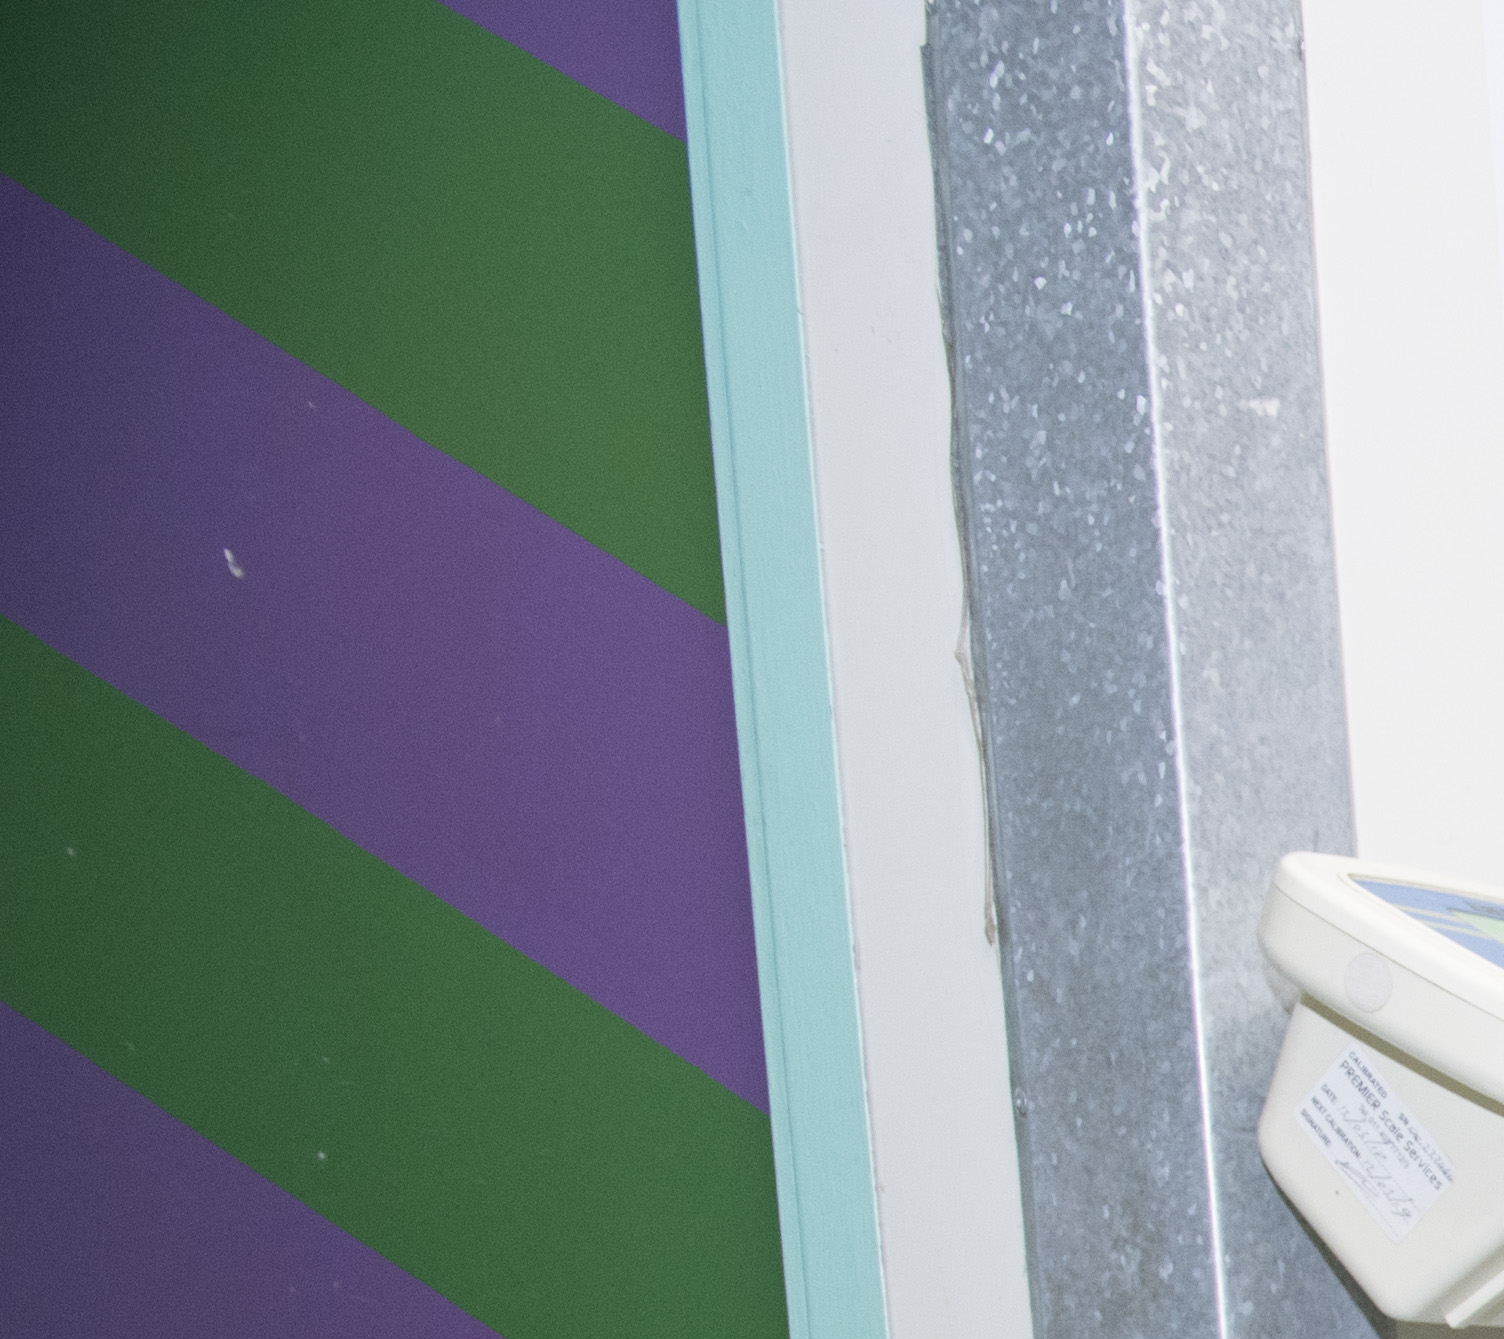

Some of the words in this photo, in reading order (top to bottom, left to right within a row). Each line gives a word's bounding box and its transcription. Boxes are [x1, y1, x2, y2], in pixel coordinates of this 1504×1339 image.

[1348, 1051, 1388, 1099] CALIBRATED
[1339, 1060, 1381, 1111] PREMIER
[1379, 1110, 1404, 1141] Scale
[1403, 1140, 1443, 1190] Services
